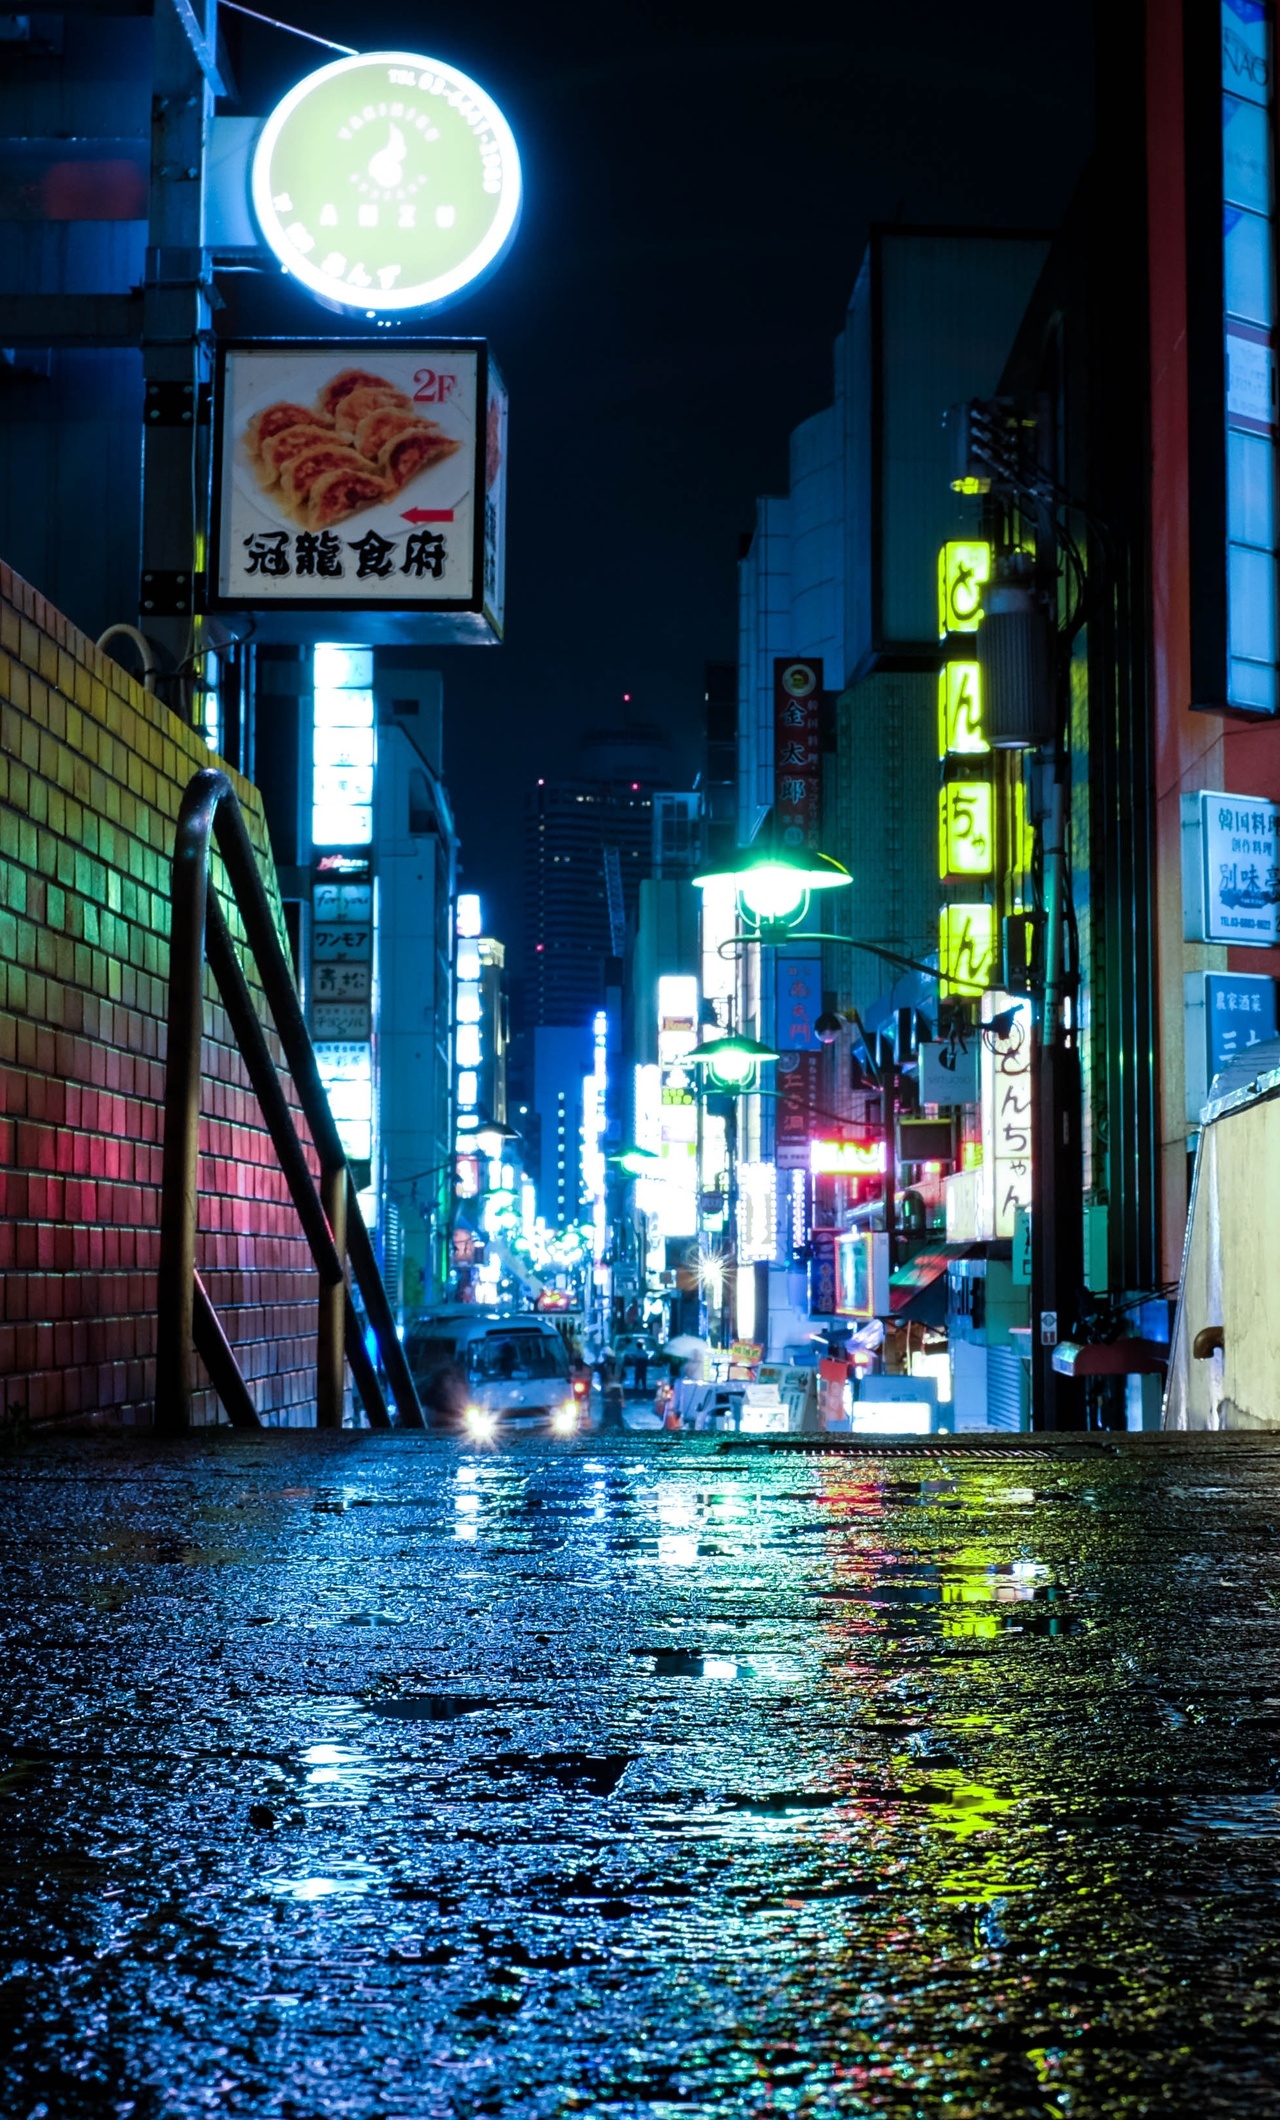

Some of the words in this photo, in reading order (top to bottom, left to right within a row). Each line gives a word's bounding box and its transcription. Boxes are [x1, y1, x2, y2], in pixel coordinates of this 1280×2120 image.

[413, 368, 457, 404] 2F
[244, 529, 446, 580] 冠龍食府
[780, 698, 807, 804] 金太郎
[315, 931, 368, 948] ワンモア
